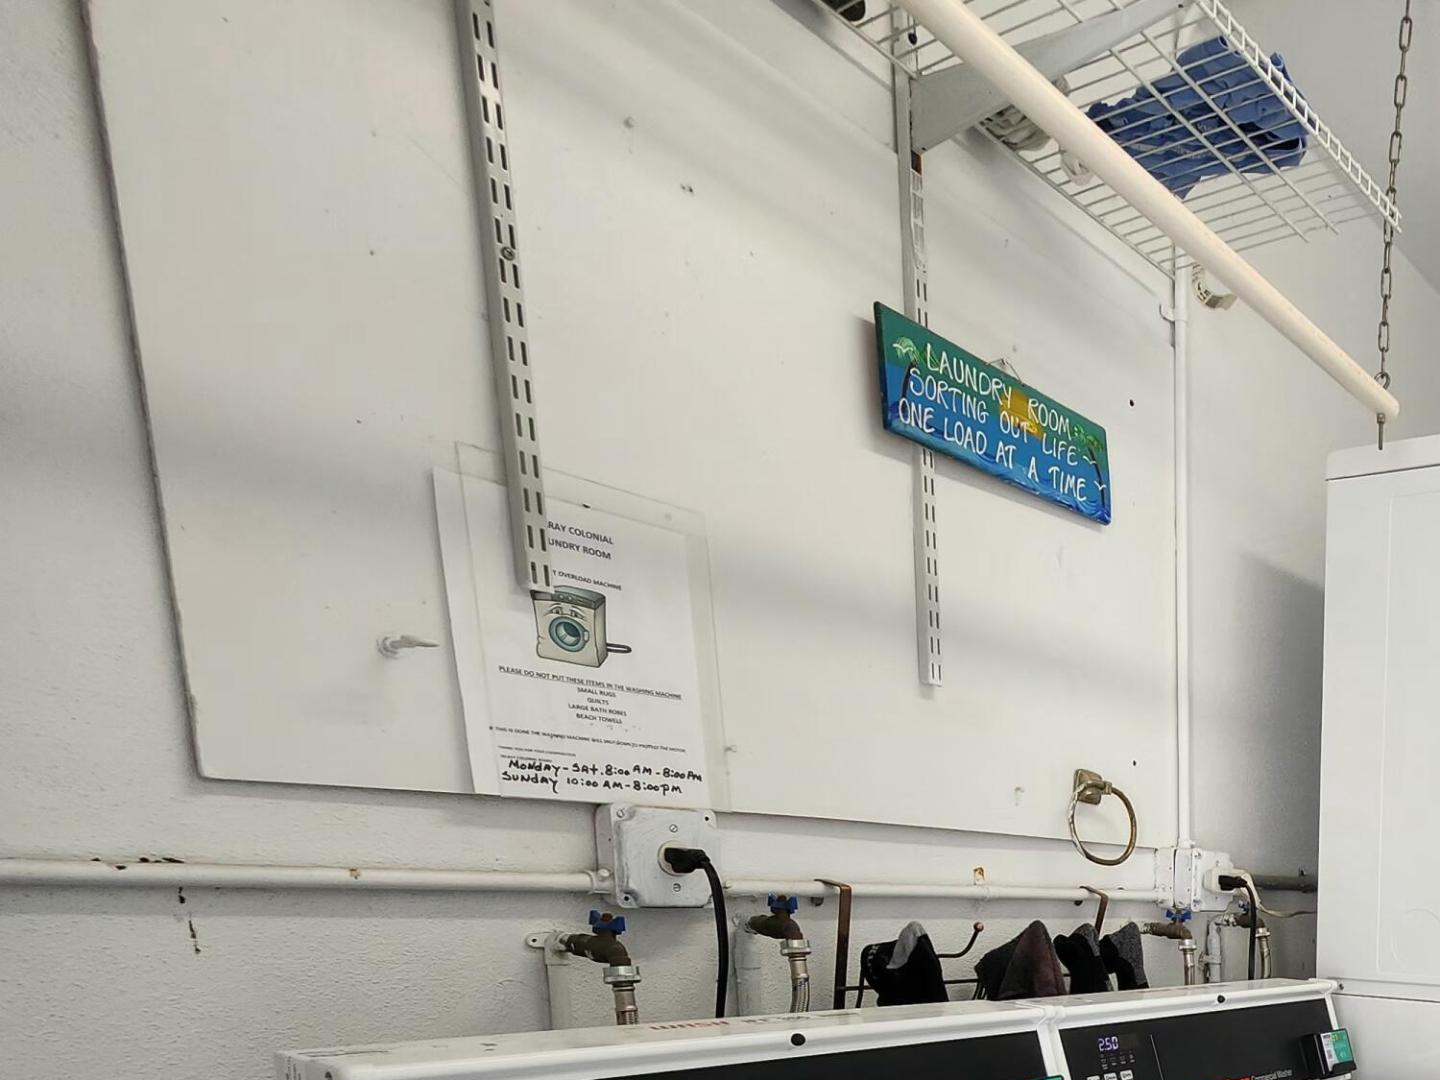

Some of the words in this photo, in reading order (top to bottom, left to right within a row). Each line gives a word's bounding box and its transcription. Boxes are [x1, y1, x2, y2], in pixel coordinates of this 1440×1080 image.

[926, 342, 1012, 409] LAUNDRY
[1027, 397, 1072, 441] ROOM
[909, 367, 989, 425] SORTING
[999, 411, 1029, 444] OUT
[1041, 433, 1079, 466] LIFE
[898, 398, 936, 433] ONE
[943, 417, 988, 455] LOAD
[995, 441, 1017, 469] AT
[1027, 457, 1039, 483] A
[1048, 466, 1088, 502] TIME
[568, 527, 614, 545] COLONIAL
[547, 538, 580, 552] UNDRY
[582, 546, 612, 560] ROOM
[567, 777, 598, 788] 10:00
[1098, 1036, 1119, 1051] 2.50
